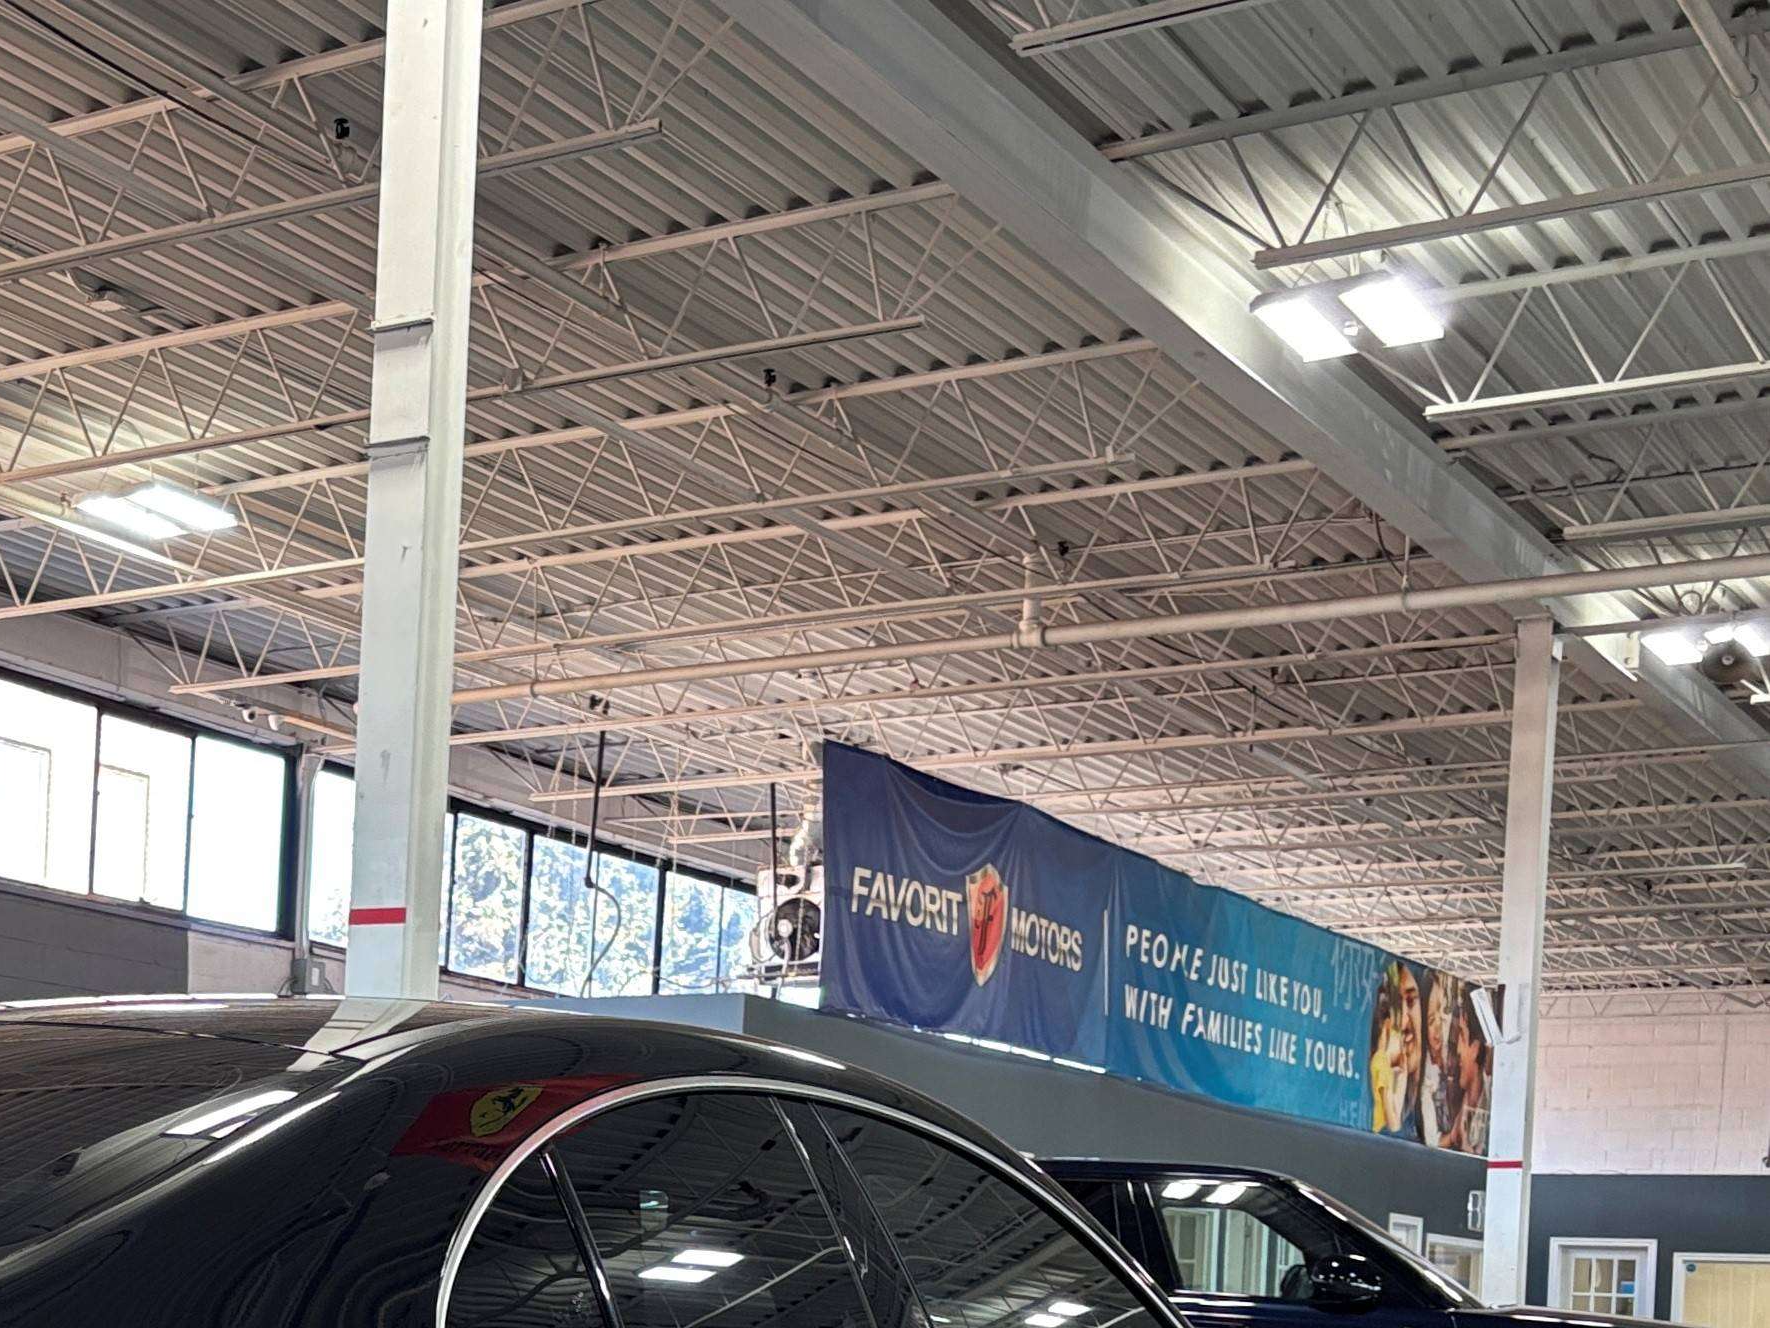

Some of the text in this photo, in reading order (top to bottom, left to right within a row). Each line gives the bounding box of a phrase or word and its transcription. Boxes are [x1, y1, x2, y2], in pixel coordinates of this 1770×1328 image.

[850, 866, 963, 936] FAVORIT
[1011, 907, 1083, 972] MOTORS
[1124, 983, 1360, 1080] WITH FAMILIES LIKE YOURS.
[1207, 954, 1248, 994] JUST
[1255, 967, 1289, 1006] LIKE
[1292, 980, 1328, 1023] YOU,
